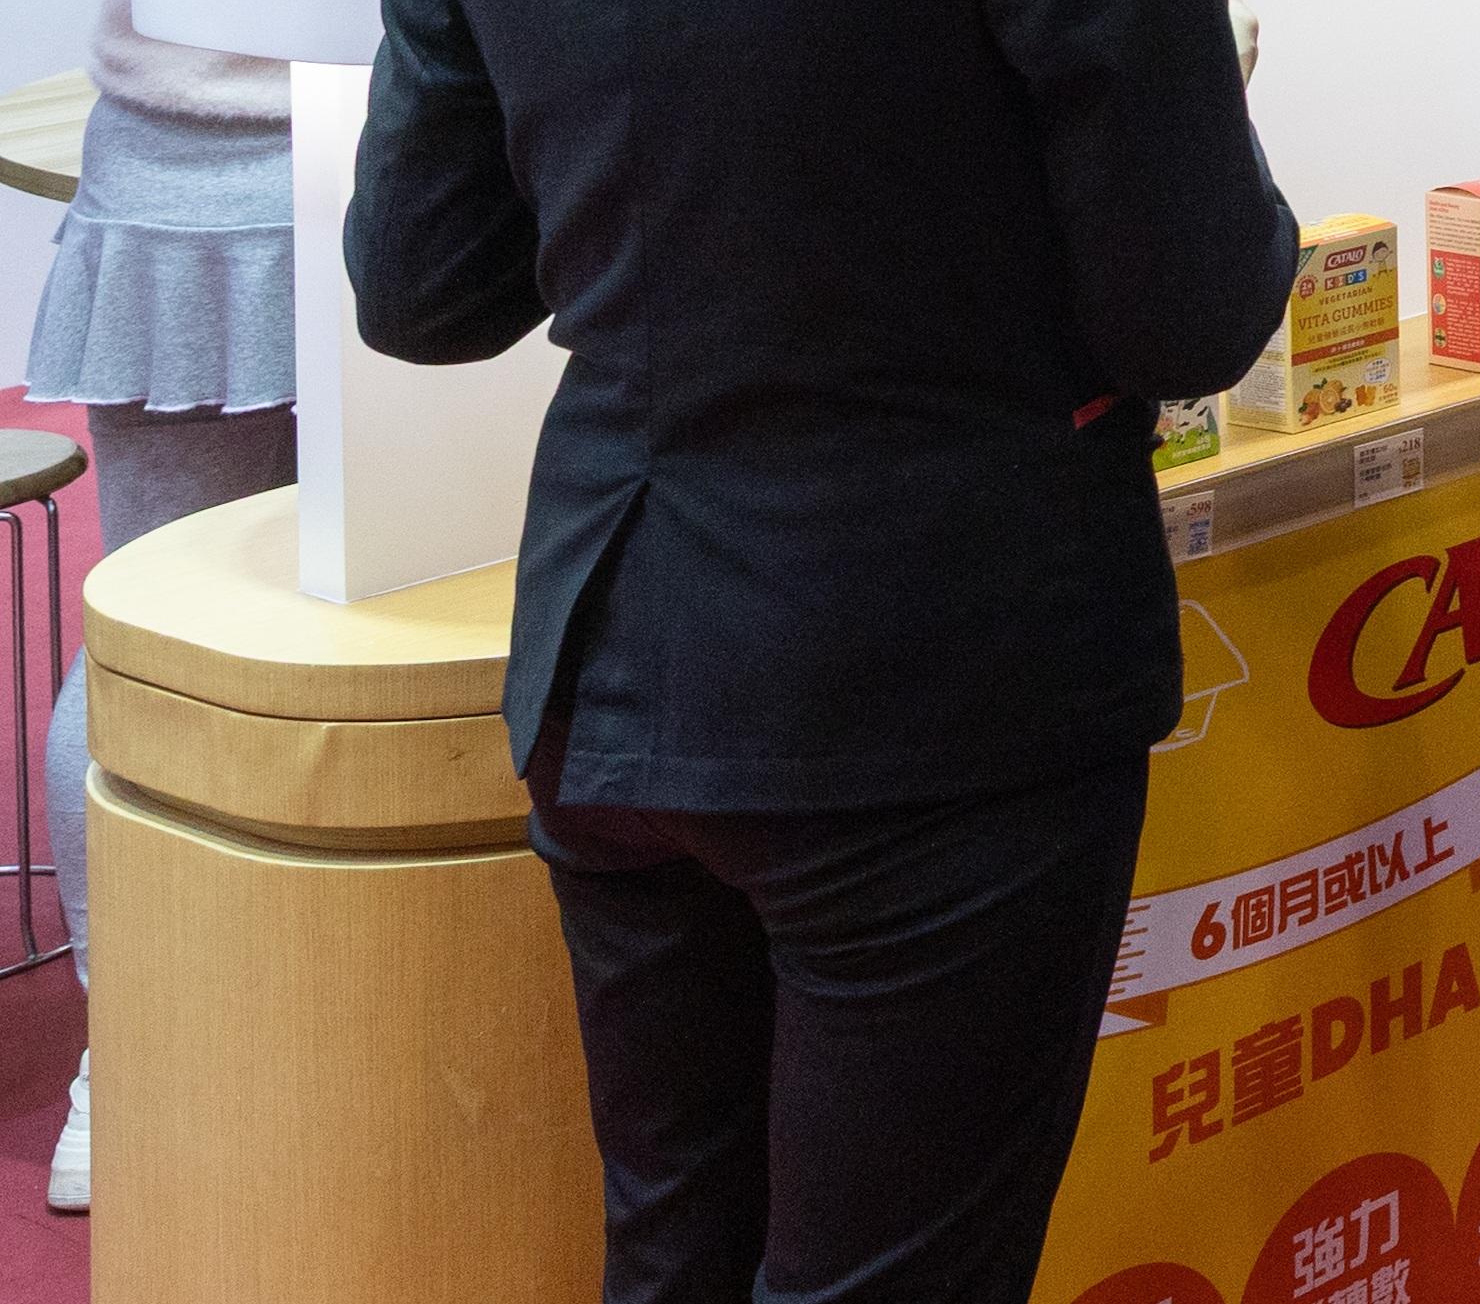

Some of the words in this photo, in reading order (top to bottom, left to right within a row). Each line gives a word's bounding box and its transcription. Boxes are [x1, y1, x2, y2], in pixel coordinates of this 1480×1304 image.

[1326, 247, 1365, 268] CATALO
[1298, 313, 1329, 331] VITA
[1332, 295, 1394, 323] GUMMIES
[1318, 286, 1374, 306] VEGETARIAN
[1189, 815, 1455, 962] 6個月或以上
[1292, 1190, 1401, 1299] 強力
